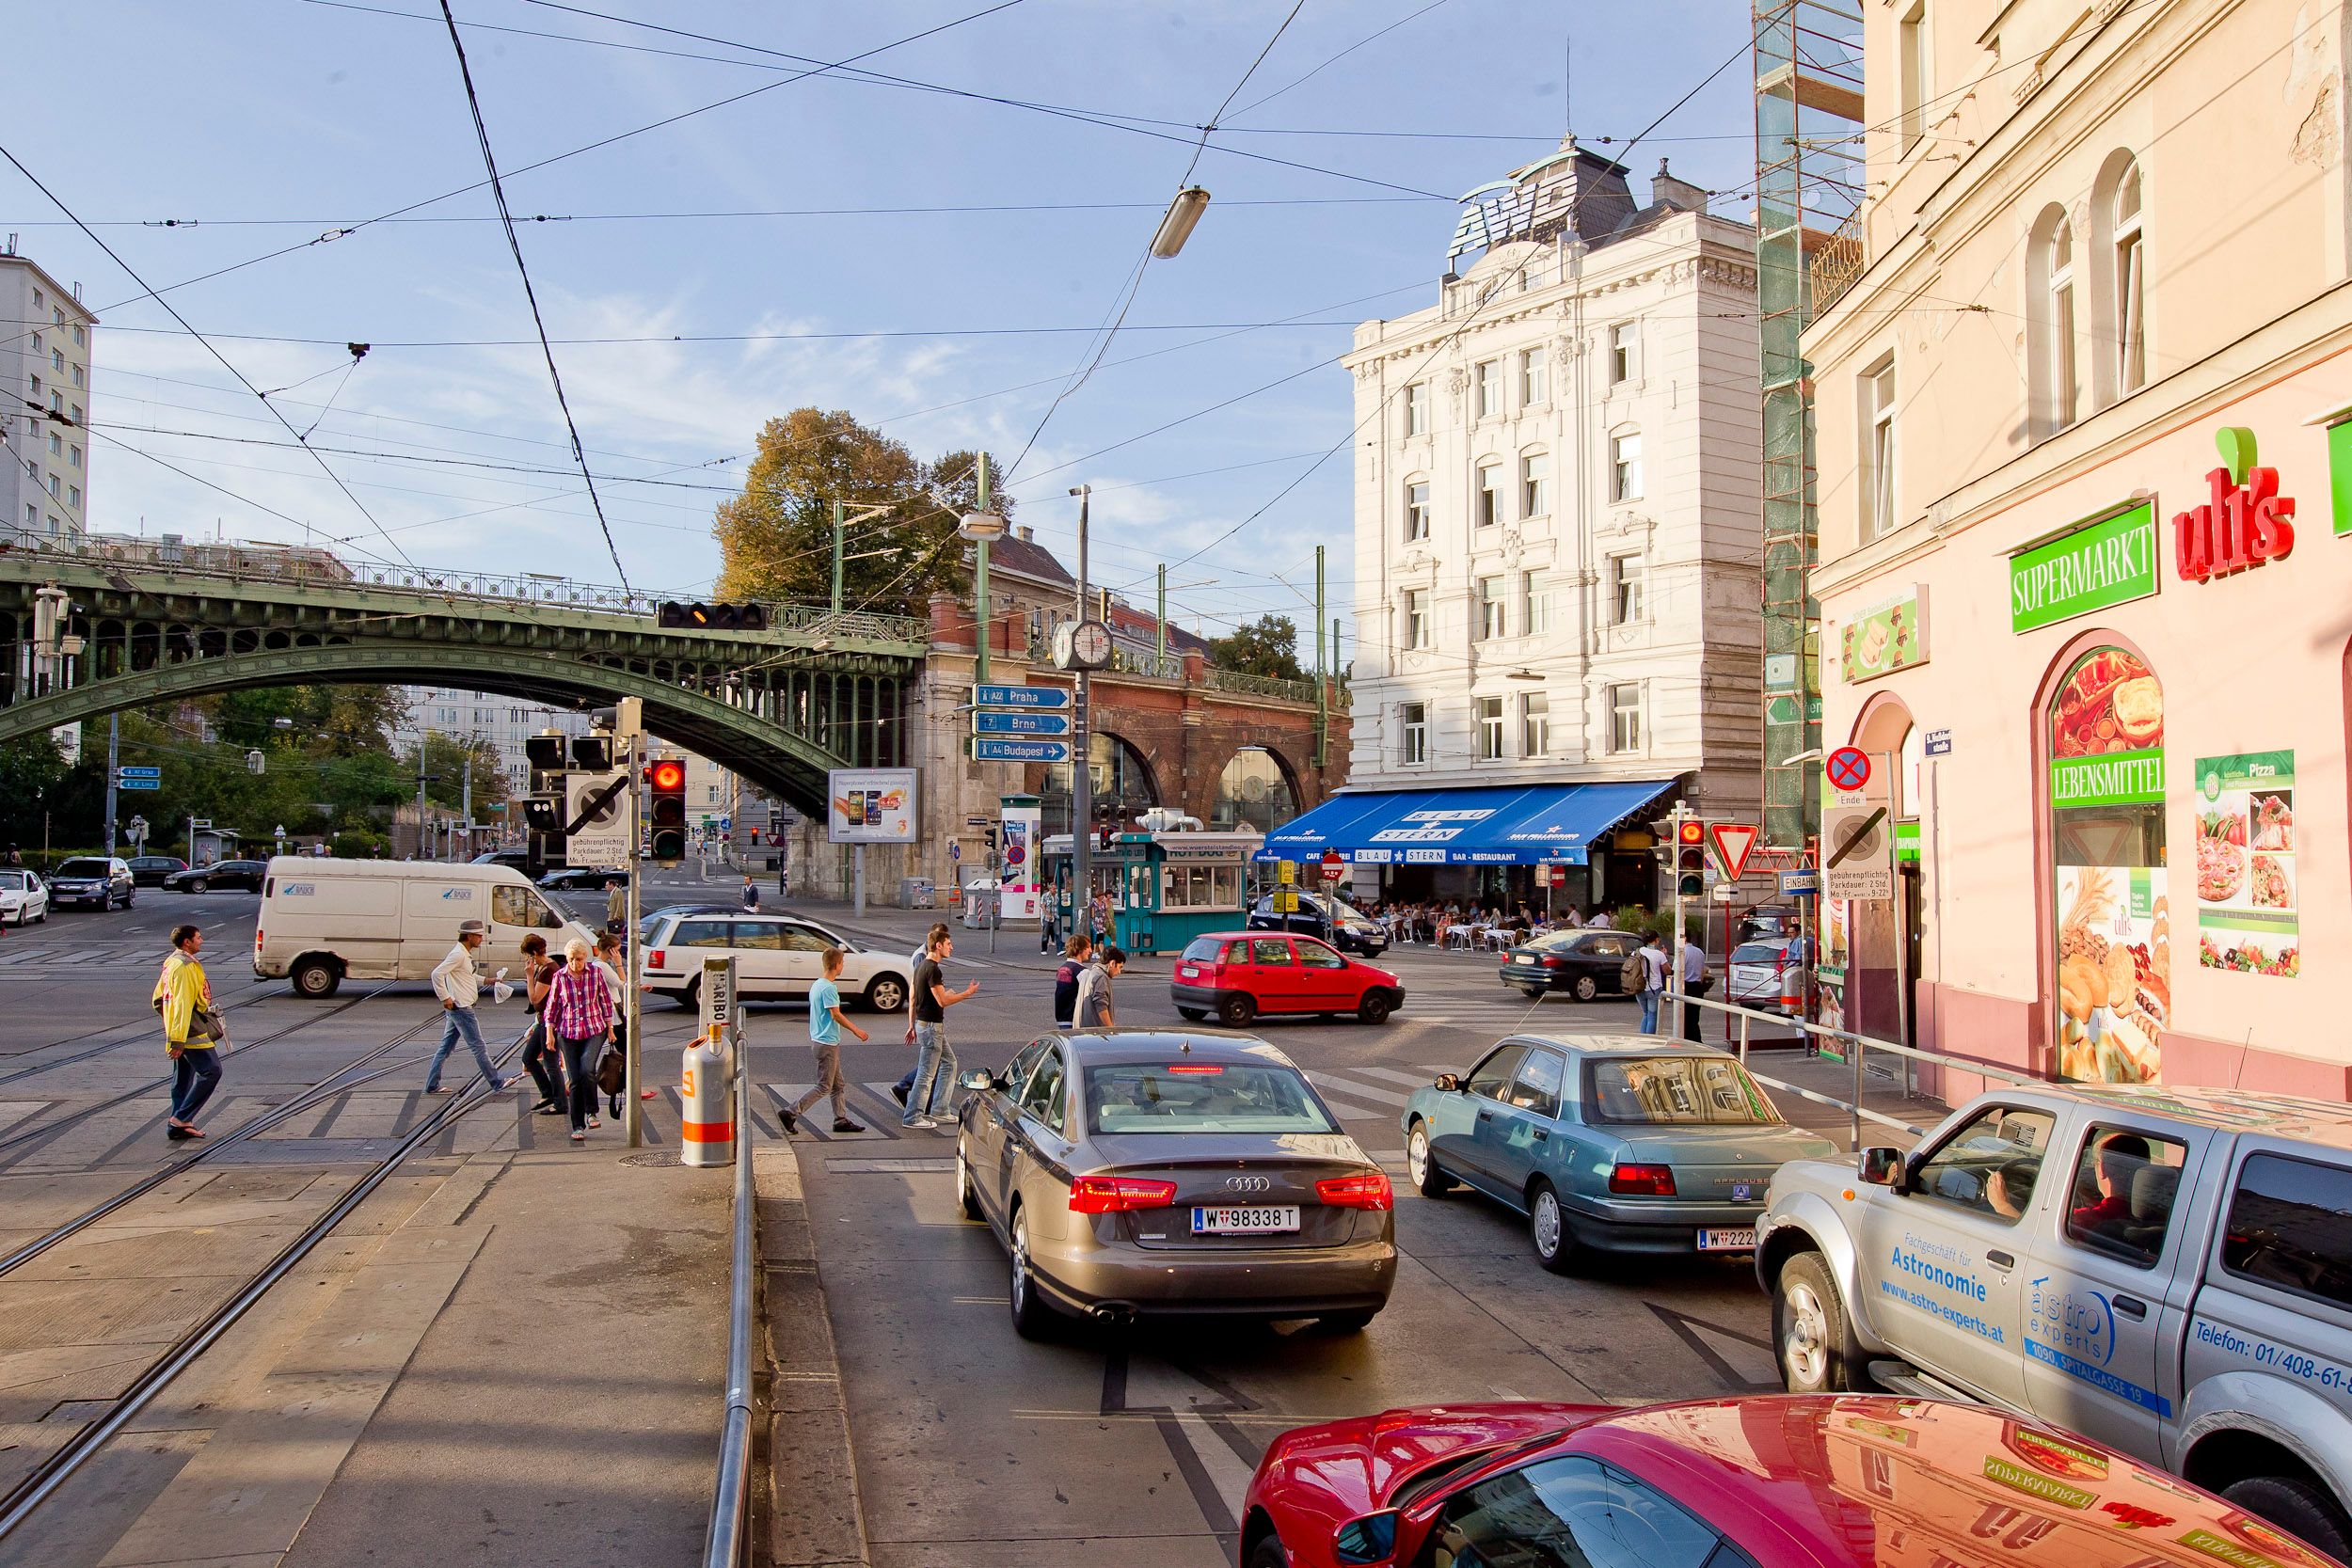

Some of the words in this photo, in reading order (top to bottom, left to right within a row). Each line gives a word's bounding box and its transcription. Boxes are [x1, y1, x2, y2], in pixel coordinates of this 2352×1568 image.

[2012, 523, 2152, 616] SUPERMARKT
[992, 690, 1002, 700] A22
[1009, 690, 1039, 702] Praha
[988, 718, 993, 727] 7
[1011, 718, 1036, 729] Brno
[992, 745, 1002, 754] A4
[1004, 744, 1043, 758] Budapest
[2249, 763, 2275, 778] Pizza
[2054, 757, 2166, 800] LEBENSMITTEL
[1840, 796, 1861, 804] Ende
[1411, 811, 1486, 819] BLAU
[1379, 831, 1454, 839] STERN
[572, 838, 625, 847] gebührenpflichtig
[573, 847, 604, 855] Parkdauer:
[1357, 850, 1390, 861] BLAU
[1409, 851, 1443, 861] STERN
[1471, 853, 1517, 862] RESTAURANT
[1829, 870, 1889, 881] gebührenpflichtig
[1786, 878, 1816, 889] EINBAHN
[1830, 880, 1867, 889] Parkdauer:
[1875, 879, 1888, 888] Std.
[1206, 1210, 1218, 1227] W
[1231, 1209, 1294, 1227] 98338T
[1710, 1231, 1720, 1246] W
[1729, 1231, 1756, 1245] 222
[1904, 1231, 1957, 1262] Fachgeschäft
[1959, 1250, 1972, 1267] für
[1891, 1246, 1986, 1302] Astronomie
[1881, 1279, 2005, 1343] www.astro-experts.at
[2030, 1288, 2101, 1336] astro
[2030, 1318, 2102, 1359] experts
[2196, 1321, 2250, 1356] Telefon:
[2031, 1342, 2059, 1367] 1090,
[2060, 1356, 2126, 1396] SPITALGASSE
[2129, 1386, 2142, 1402] 19
